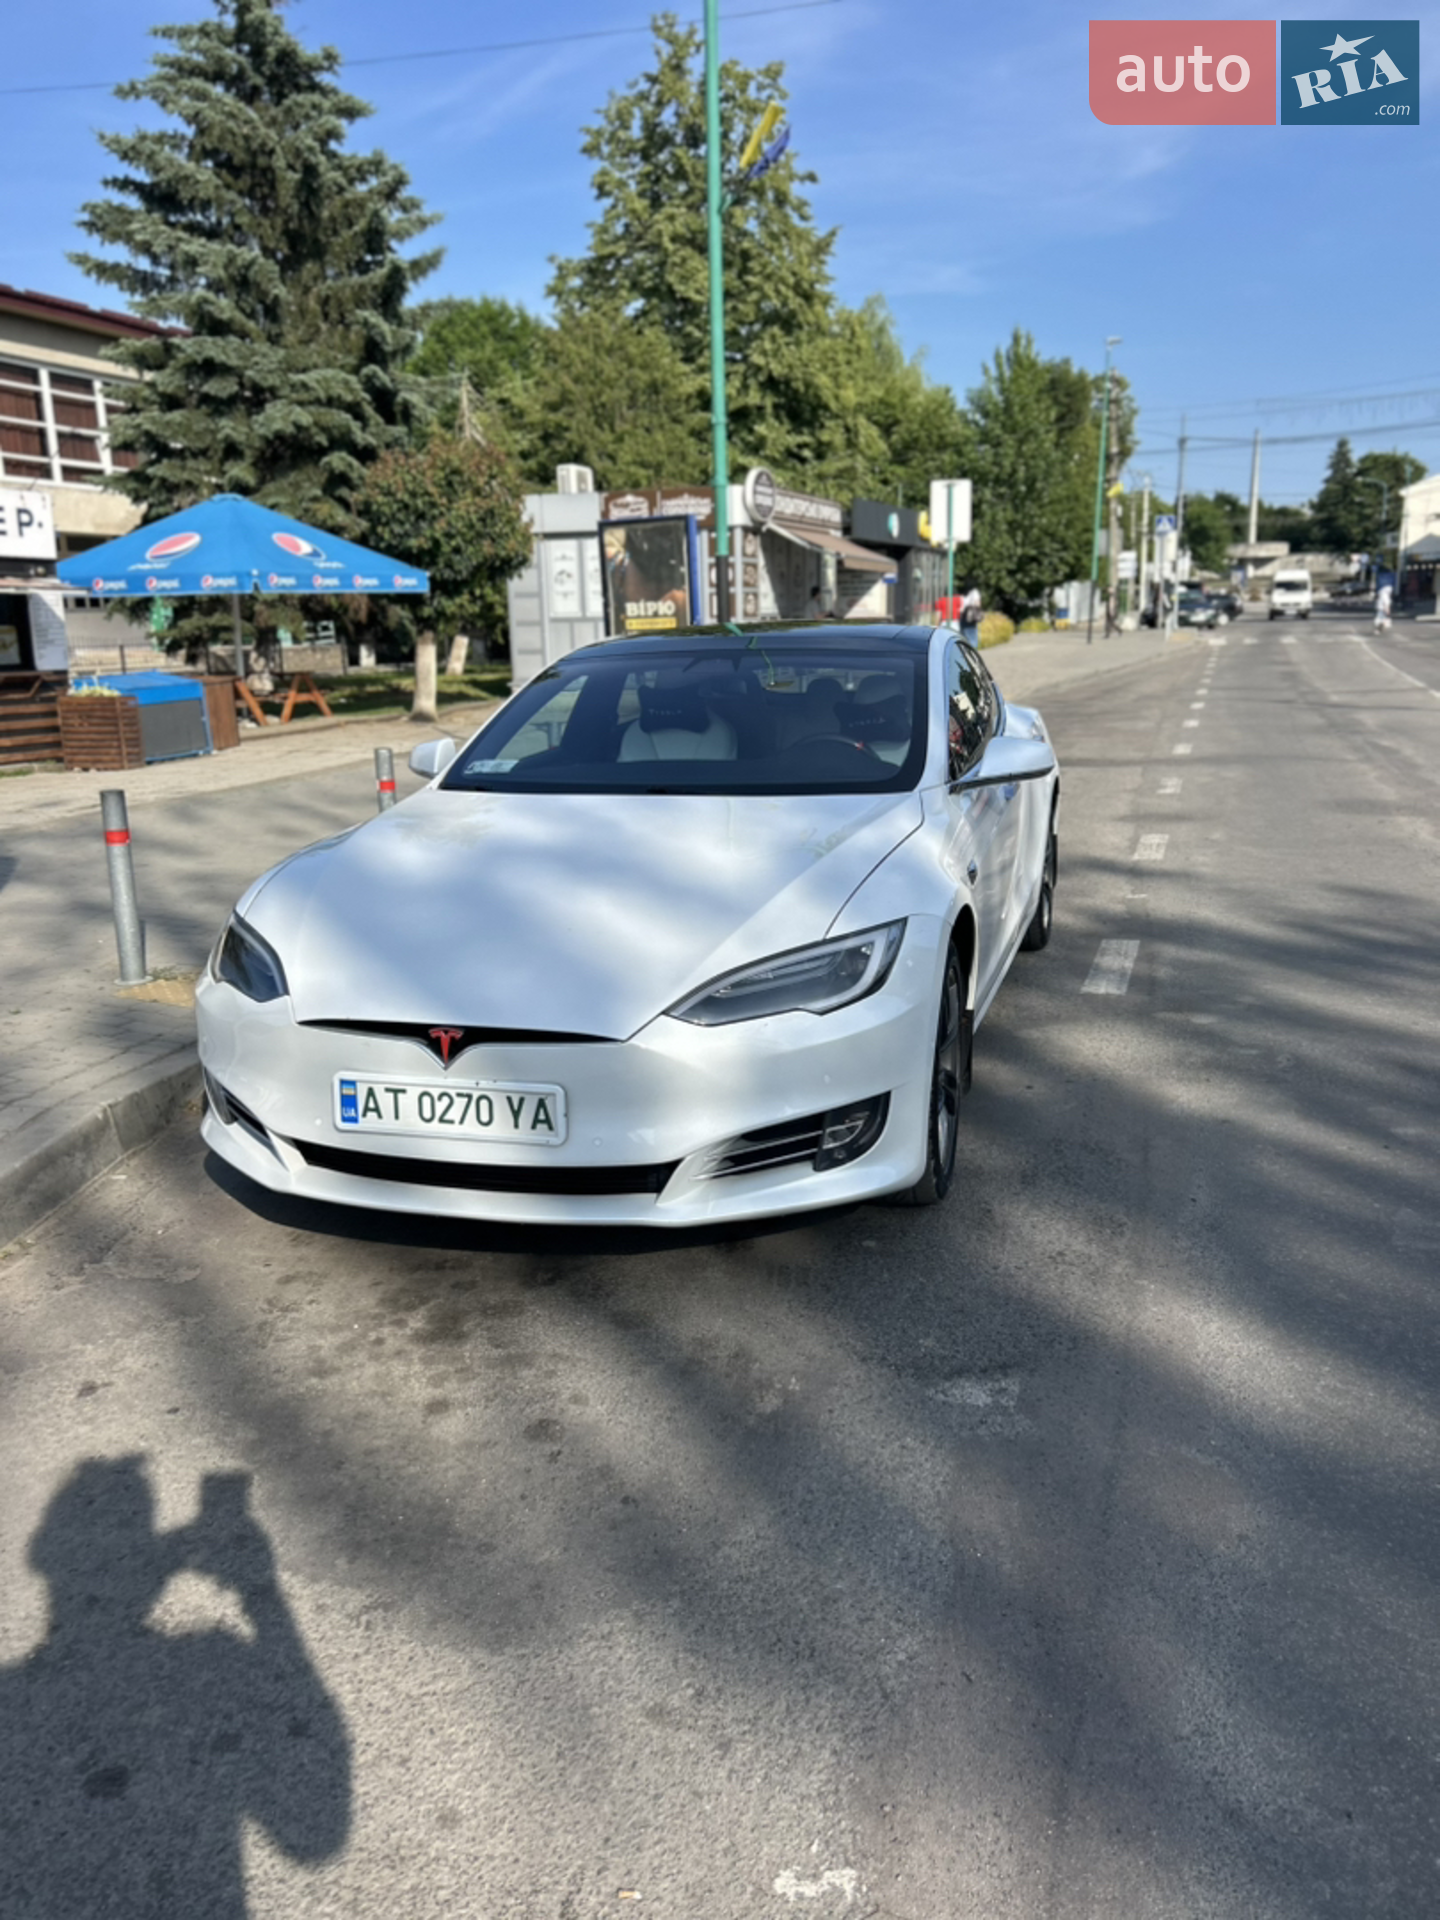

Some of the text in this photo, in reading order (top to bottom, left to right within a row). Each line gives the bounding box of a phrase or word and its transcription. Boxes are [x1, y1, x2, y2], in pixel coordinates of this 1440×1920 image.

[342, 1106, 357, 1117] UA
[361, 1086, 554, 1131] AT 0270 YA
